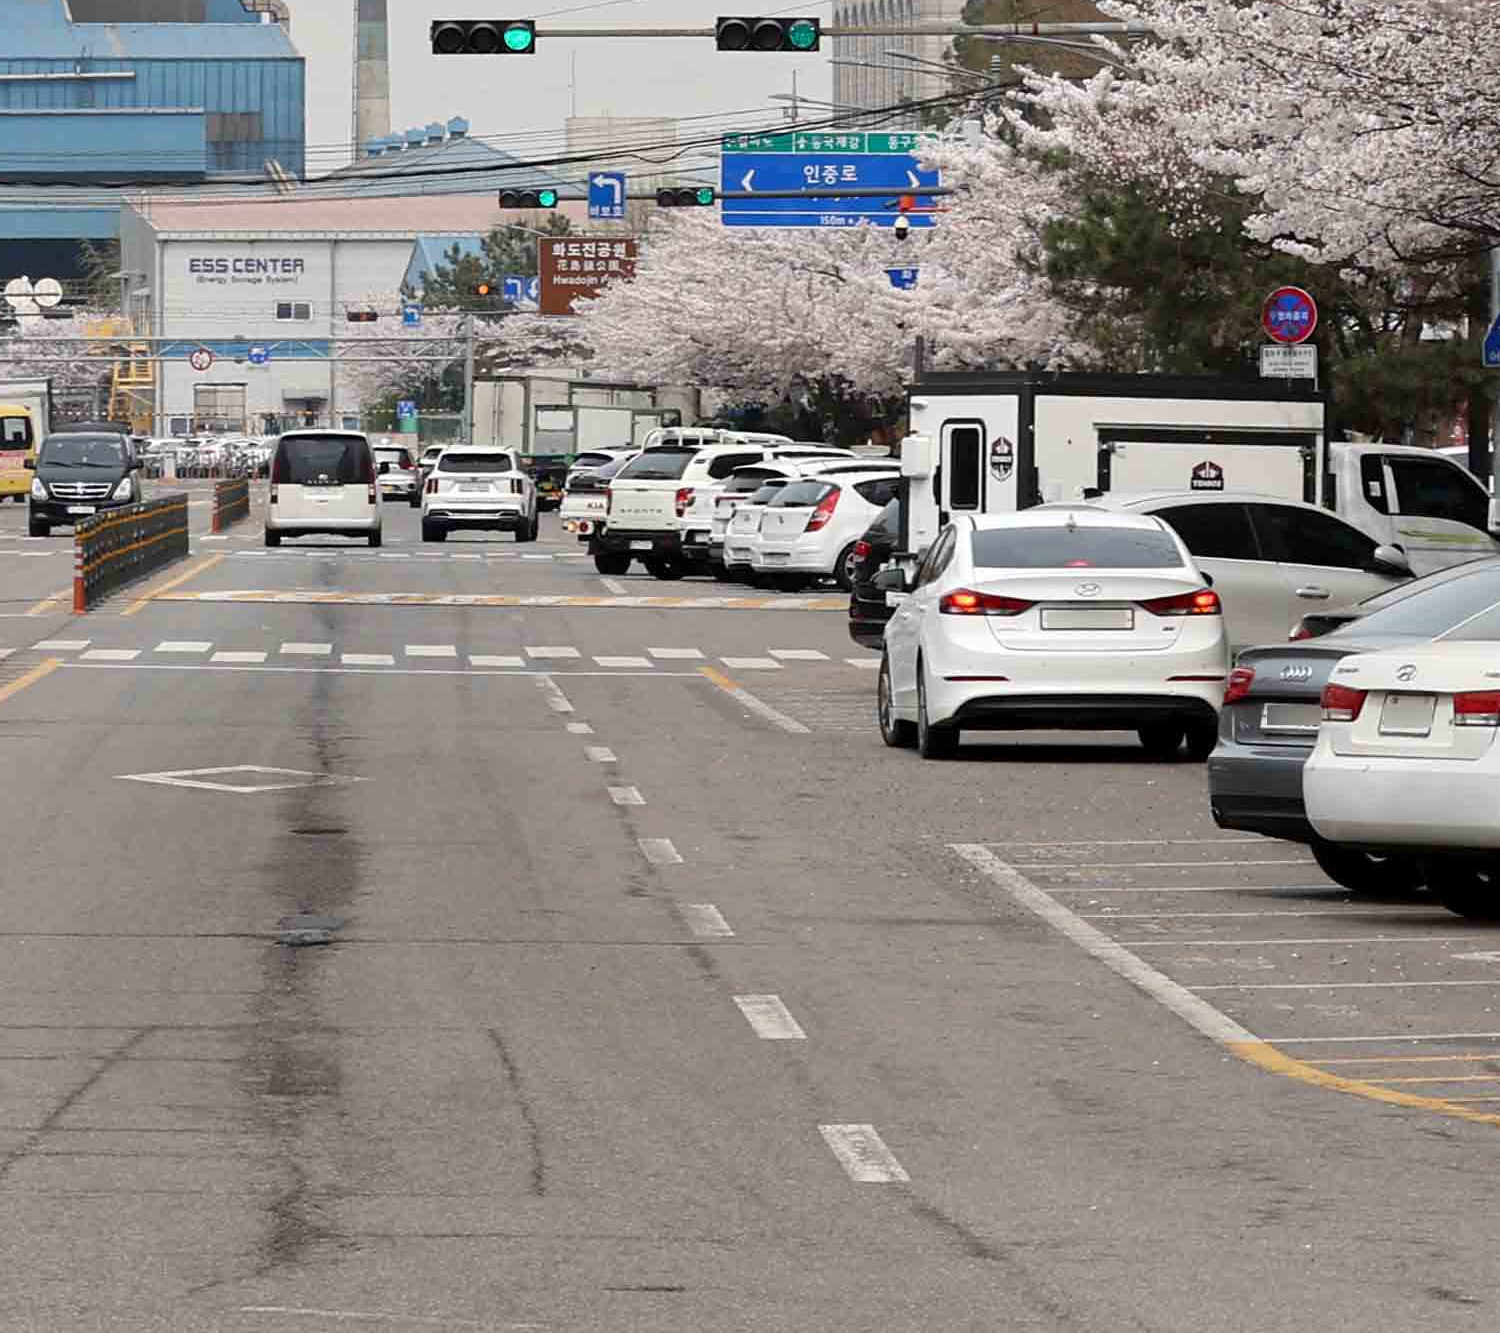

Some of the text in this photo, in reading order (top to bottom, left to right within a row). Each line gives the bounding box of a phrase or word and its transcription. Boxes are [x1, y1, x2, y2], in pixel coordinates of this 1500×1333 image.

[552, 242, 627, 259] 화도진공원
[189, 258, 305, 273] ESS CENTER
